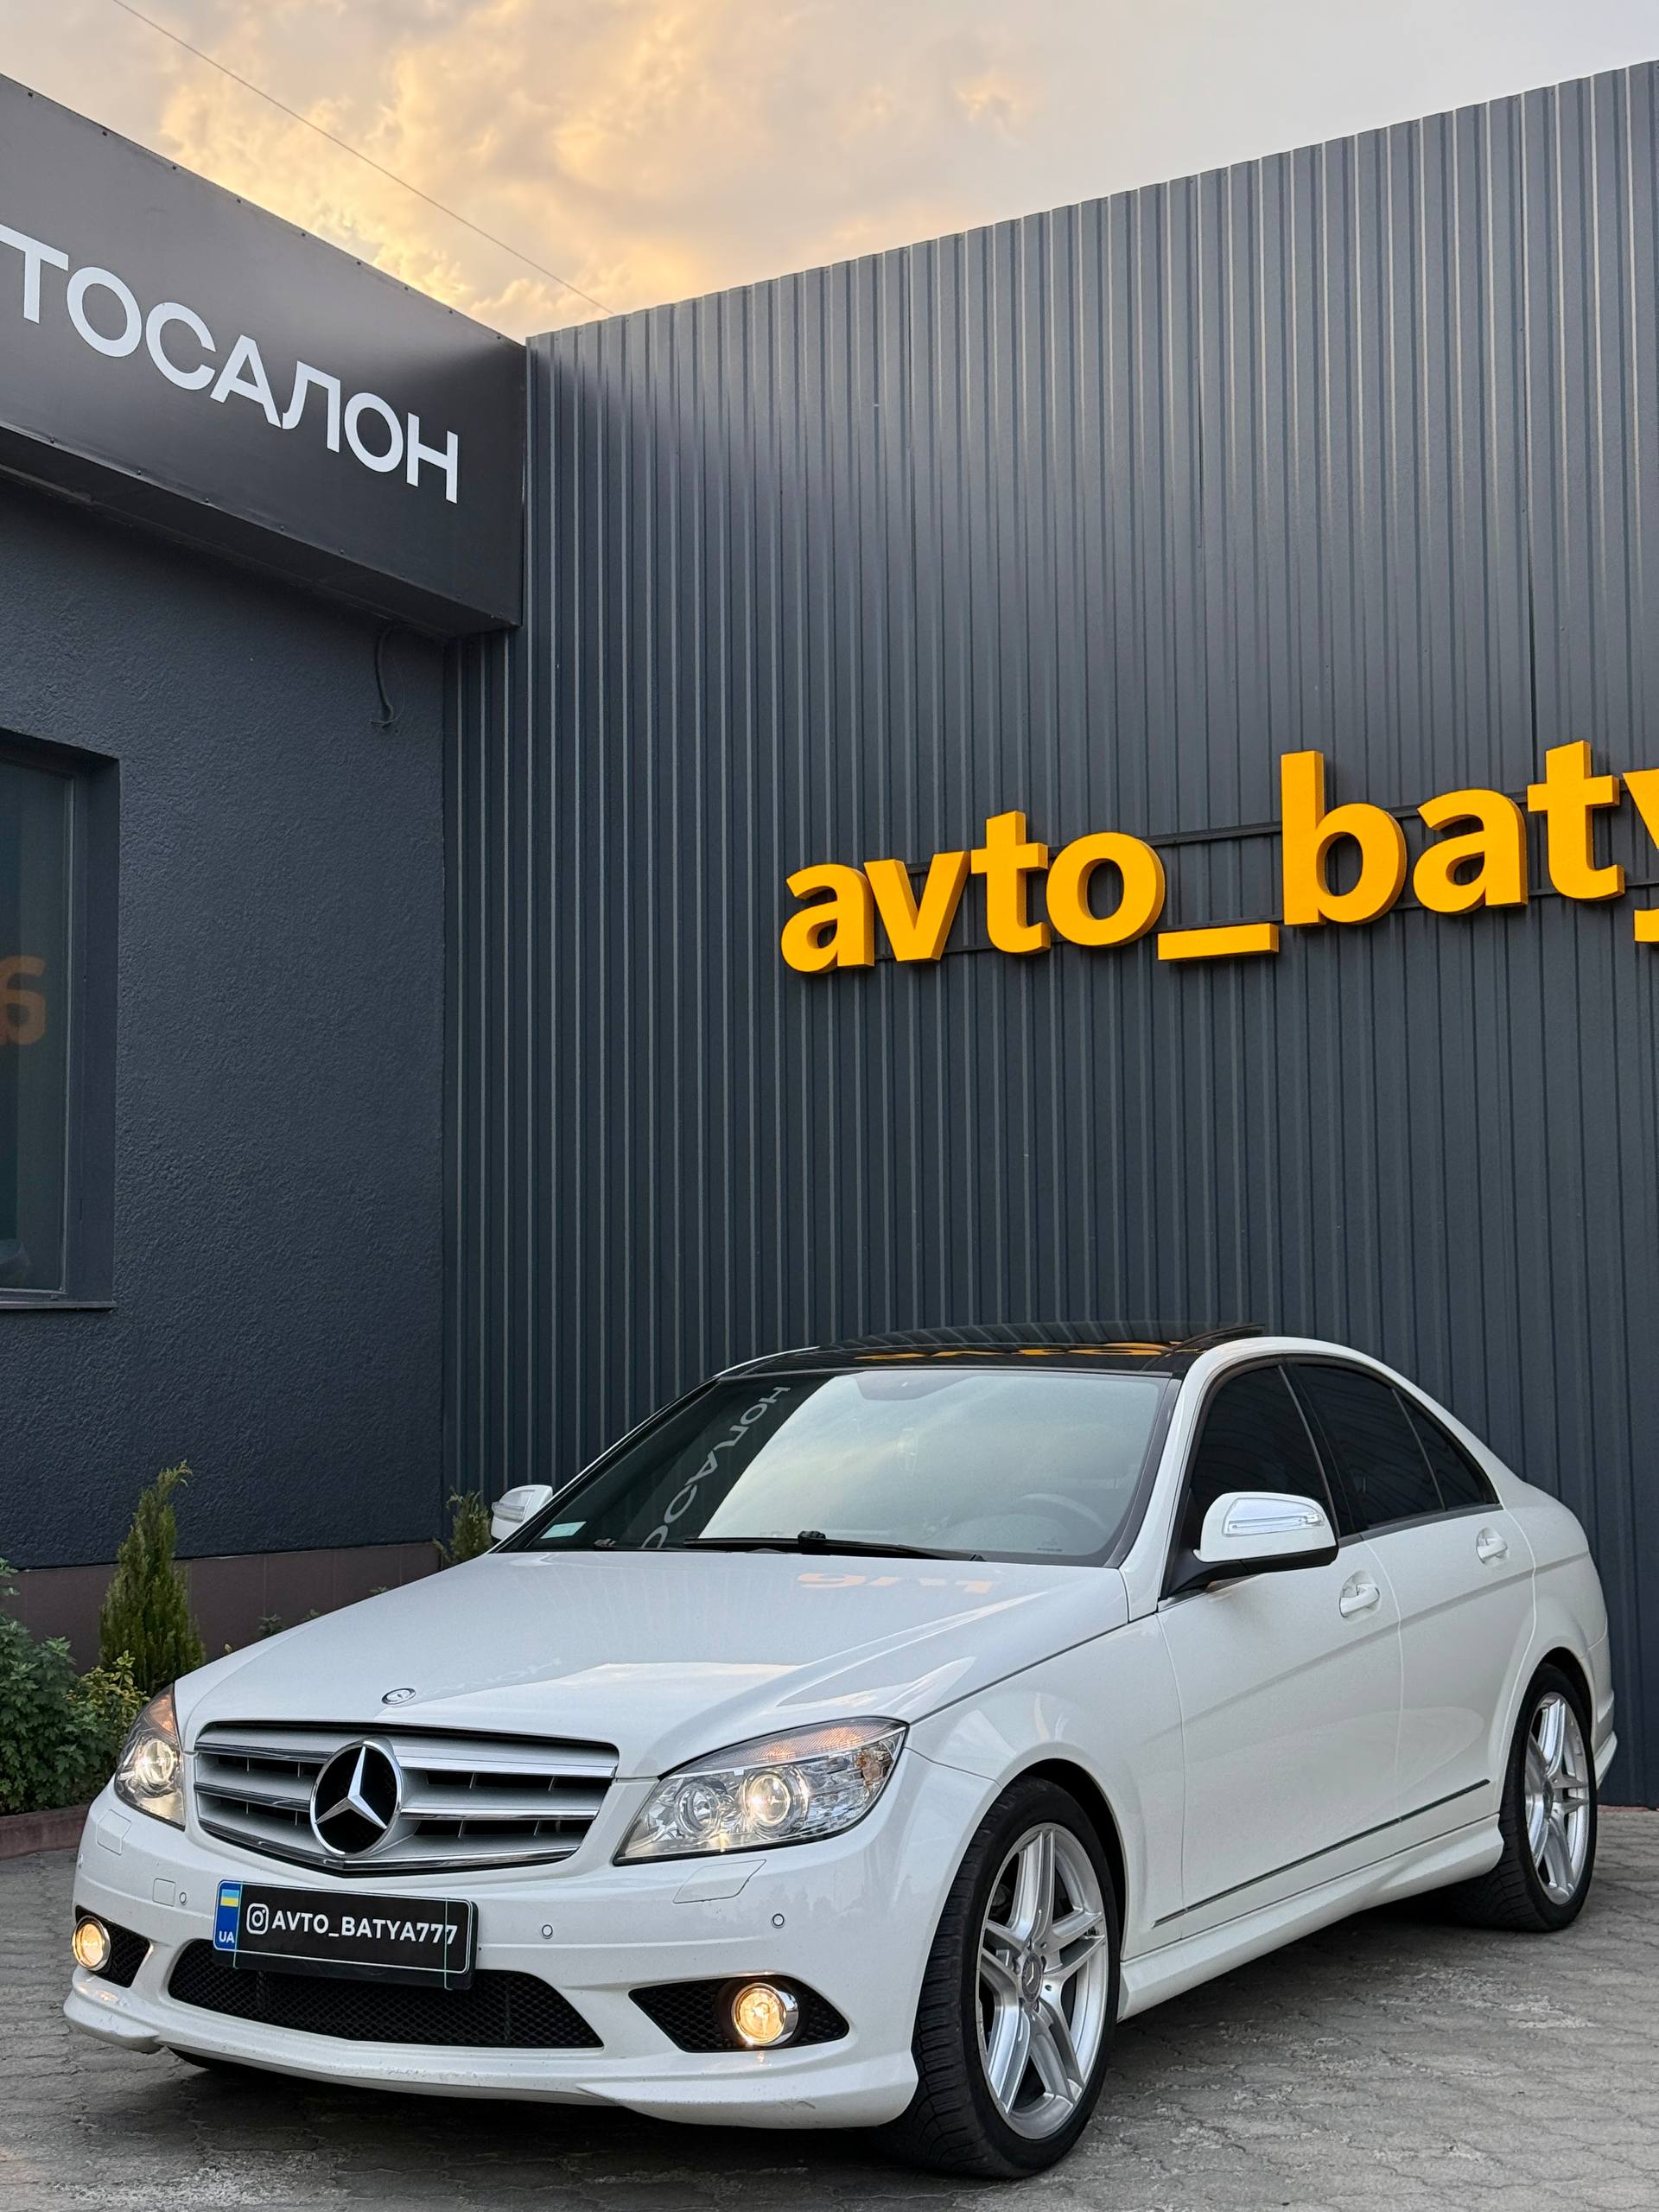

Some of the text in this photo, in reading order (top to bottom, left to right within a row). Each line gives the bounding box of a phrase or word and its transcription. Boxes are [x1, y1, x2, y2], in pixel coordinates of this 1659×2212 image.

[0, 224, 458, 503] ТОСАЛОН
[218, 1931, 235, 1944] UA
[271, 1910, 458, 1945] AVTO_BATYA777
